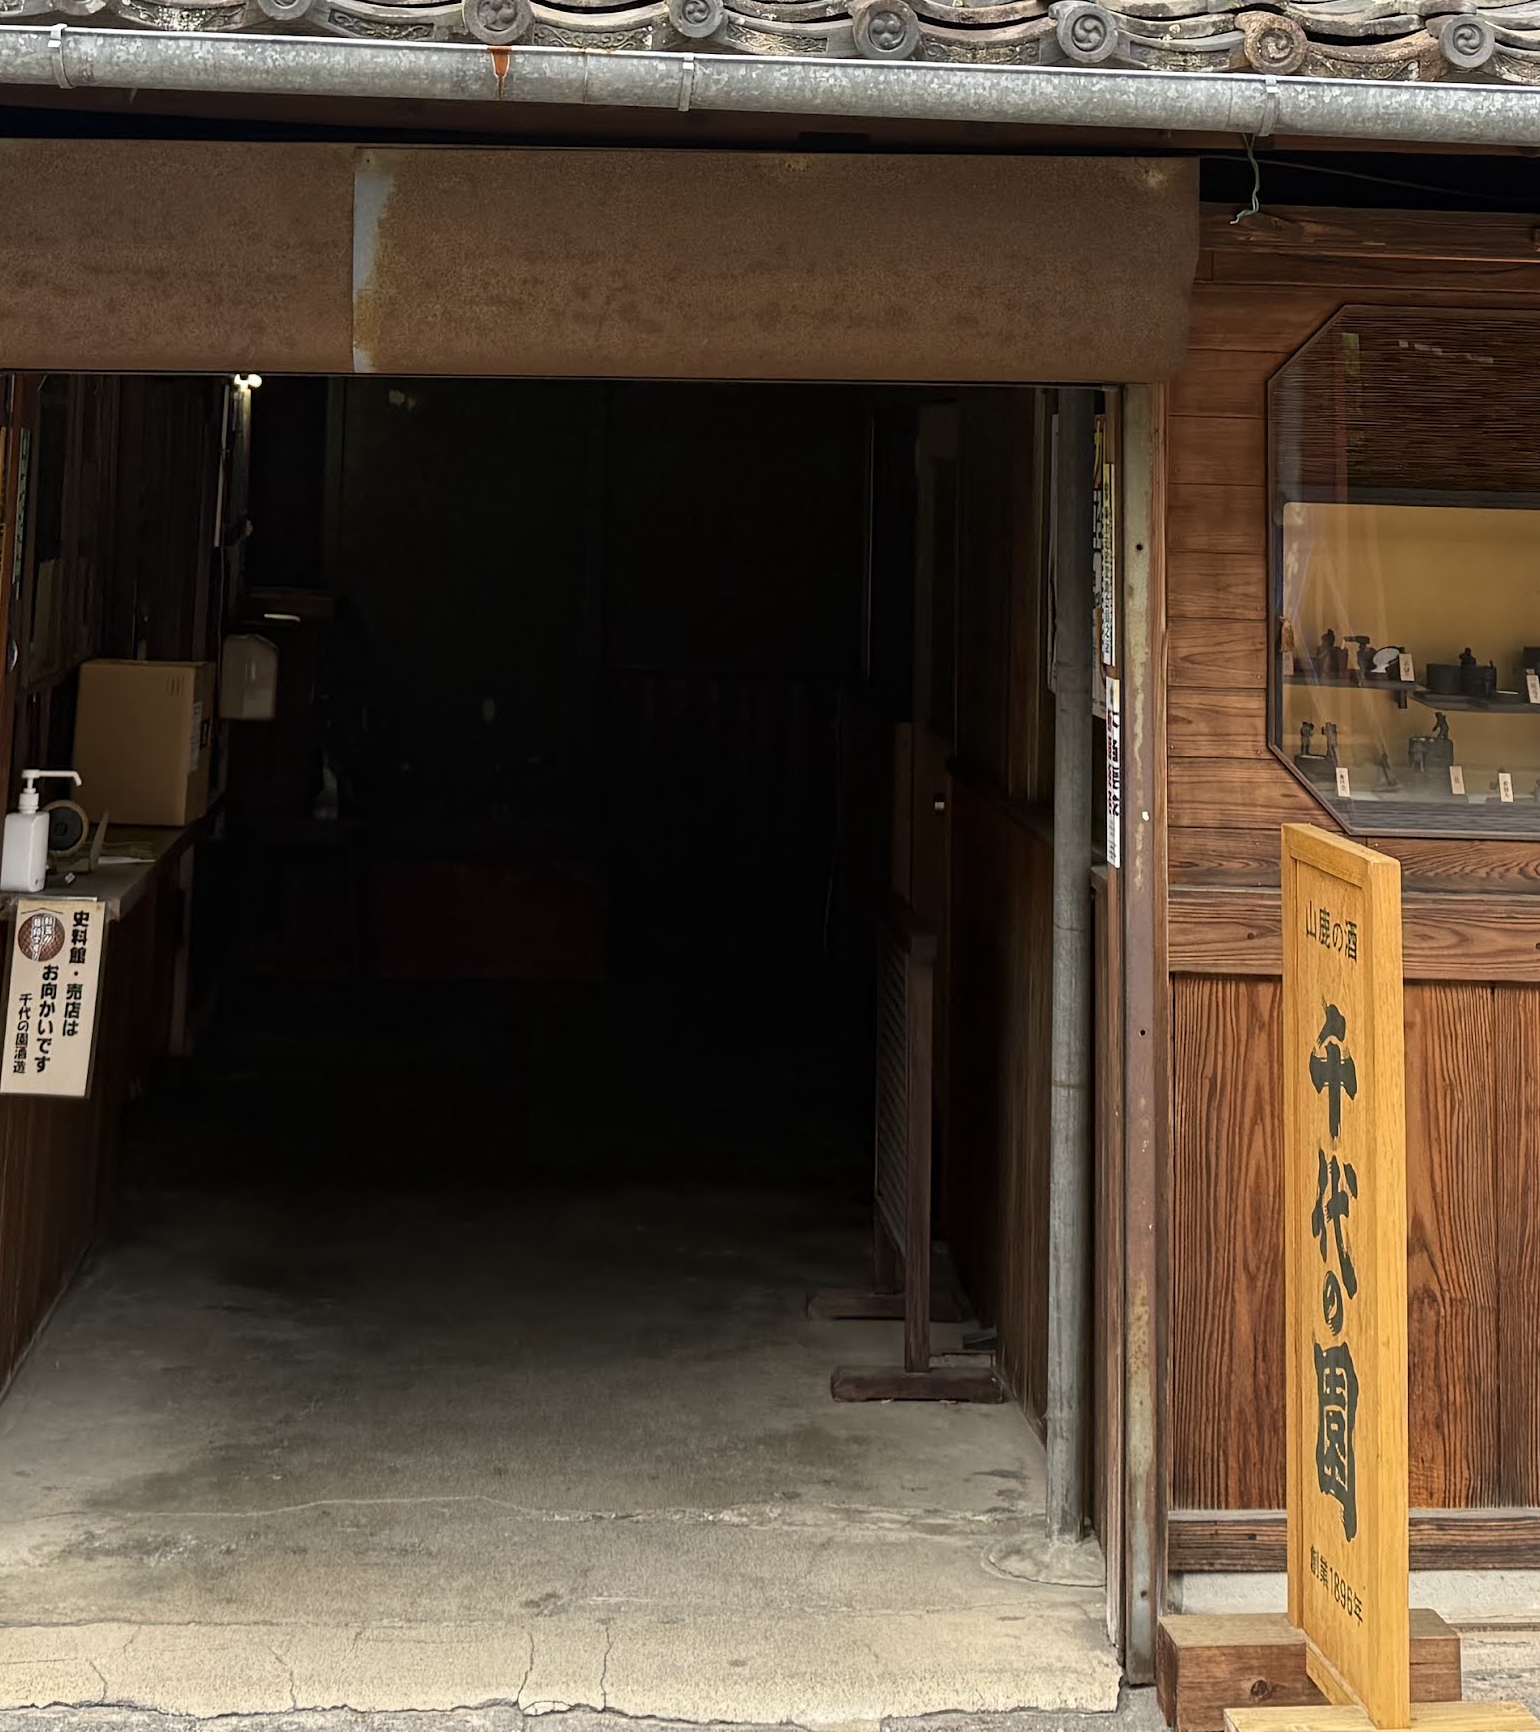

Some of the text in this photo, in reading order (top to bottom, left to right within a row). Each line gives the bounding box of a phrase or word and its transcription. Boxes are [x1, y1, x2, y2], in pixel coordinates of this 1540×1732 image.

[62, 910, 90, 1037] 史料館・売店は
[1305, 900, 1358, 964] 山鹿の酒
[13, 993, 33, 1074] 千代の園酒造
[34, 965, 59, 1073] お向かいです
[1308, 1002, 1359, 1543] 千代の園
[1310, 1544, 1364, 1627] 創業1896年
